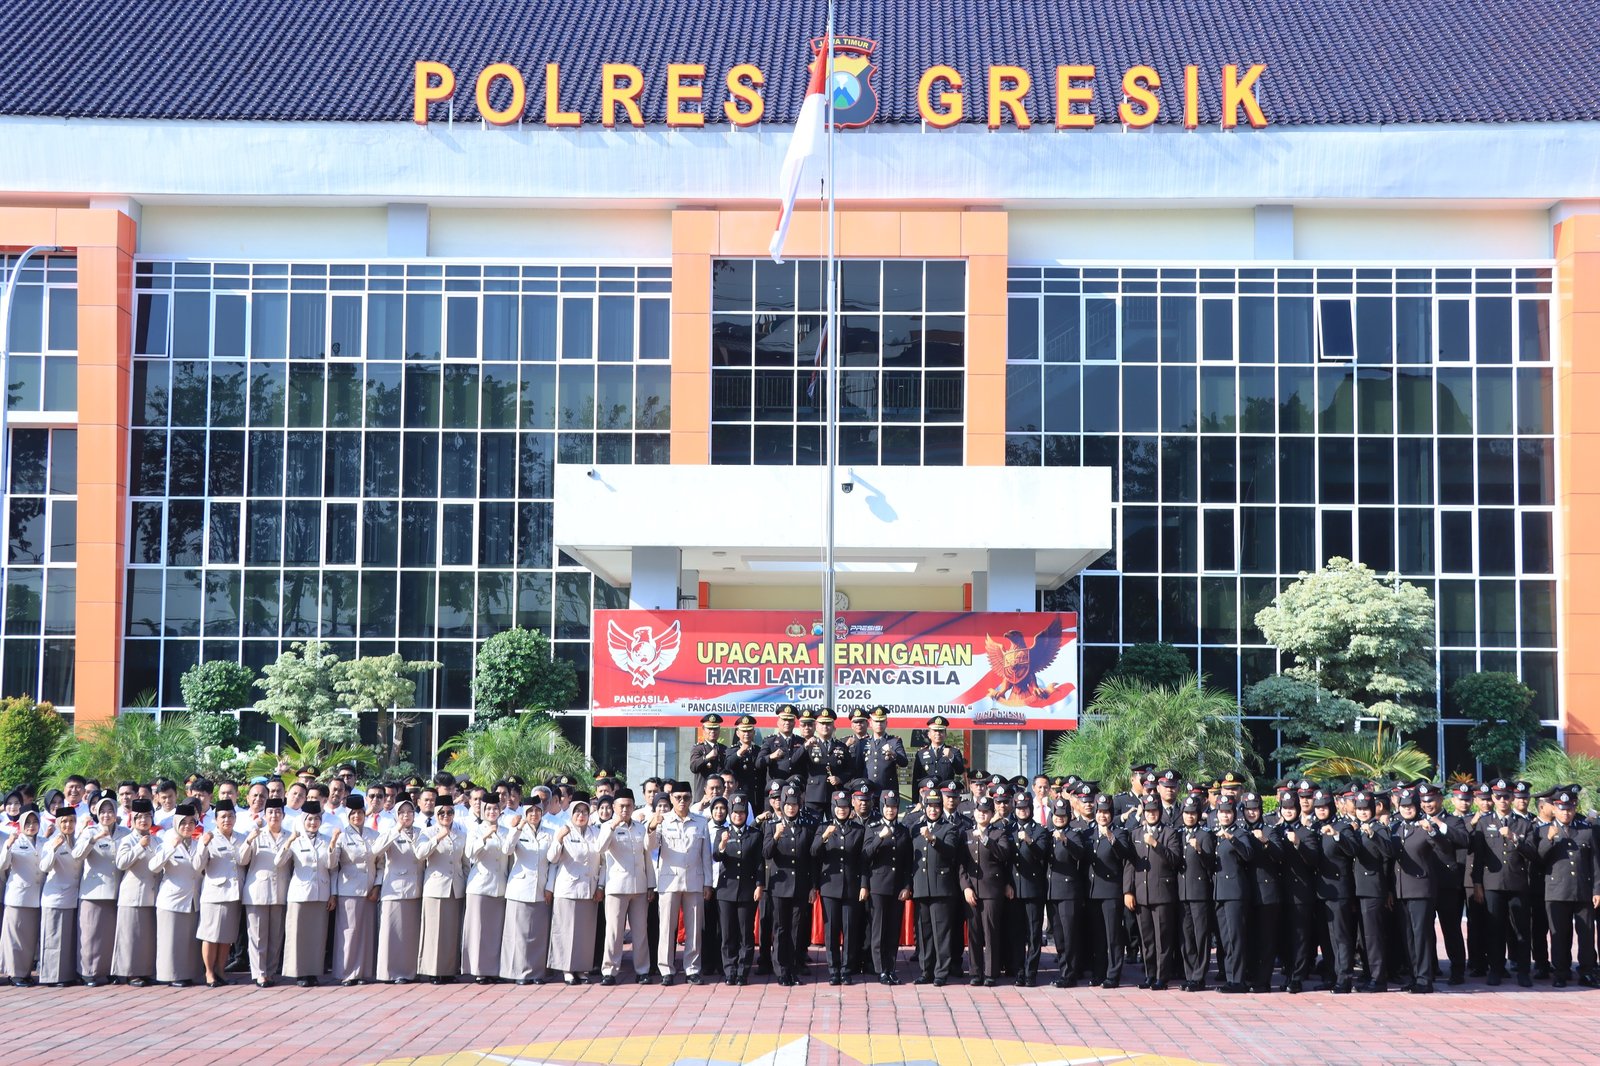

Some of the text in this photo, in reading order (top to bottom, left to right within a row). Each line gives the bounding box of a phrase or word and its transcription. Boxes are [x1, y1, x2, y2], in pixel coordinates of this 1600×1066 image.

[843, 38, 869, 49] TIMUR
[414, 61, 1268, 129] POLRES GRESIK
[697, 642, 811, 665] UPACARA
[707, 668, 759, 684] HARI
[838, 670, 960, 685] PANCASILA
[613, 695, 670, 703] PANCASILA
[787, 689, 871, 700] 1 JUN 2026
[688, 703, 736, 712] PANCASILA
[937, 705, 966, 713] DUNIA
